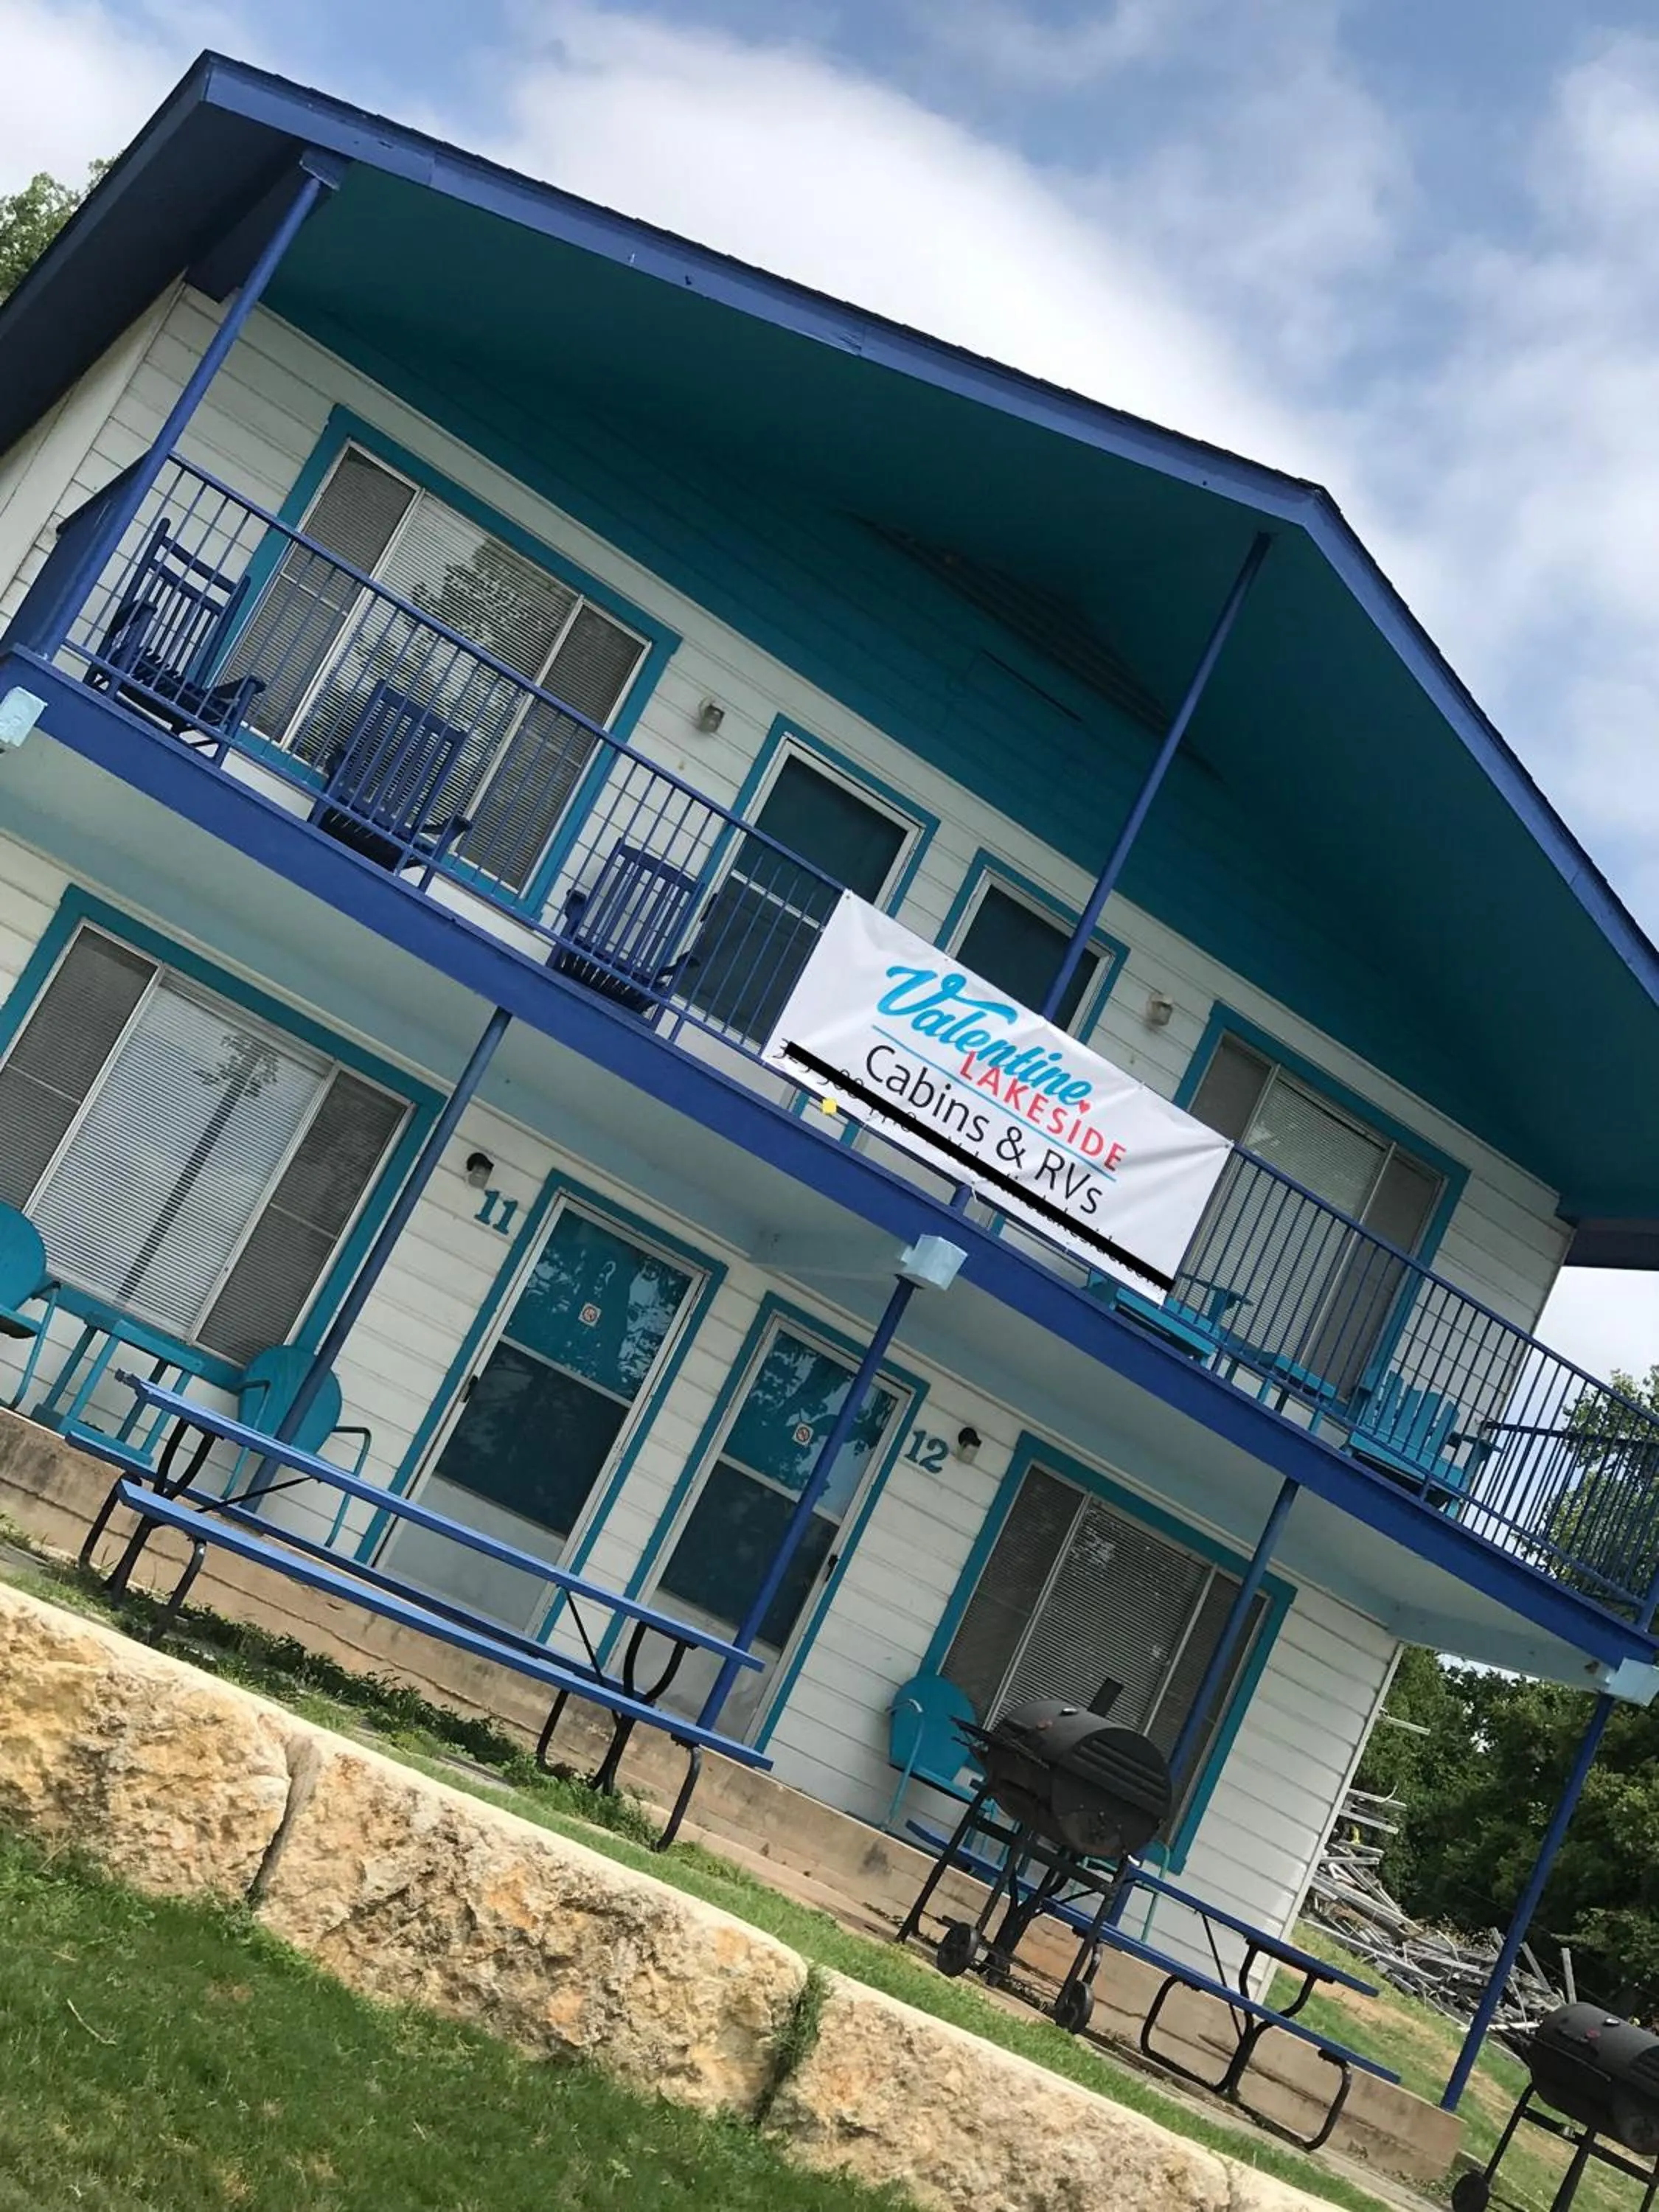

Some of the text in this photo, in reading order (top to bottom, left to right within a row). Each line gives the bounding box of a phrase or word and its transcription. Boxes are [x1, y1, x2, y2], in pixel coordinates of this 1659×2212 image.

[877, 965, 1093, 1106] Valentine
[866, 1045, 1102, 1214] Cabins & RVs
[960, 1051, 1127, 1171] LAKESIDE
[474, 1189, 518, 1235] 11
[904, 1429, 949, 1474] 12
